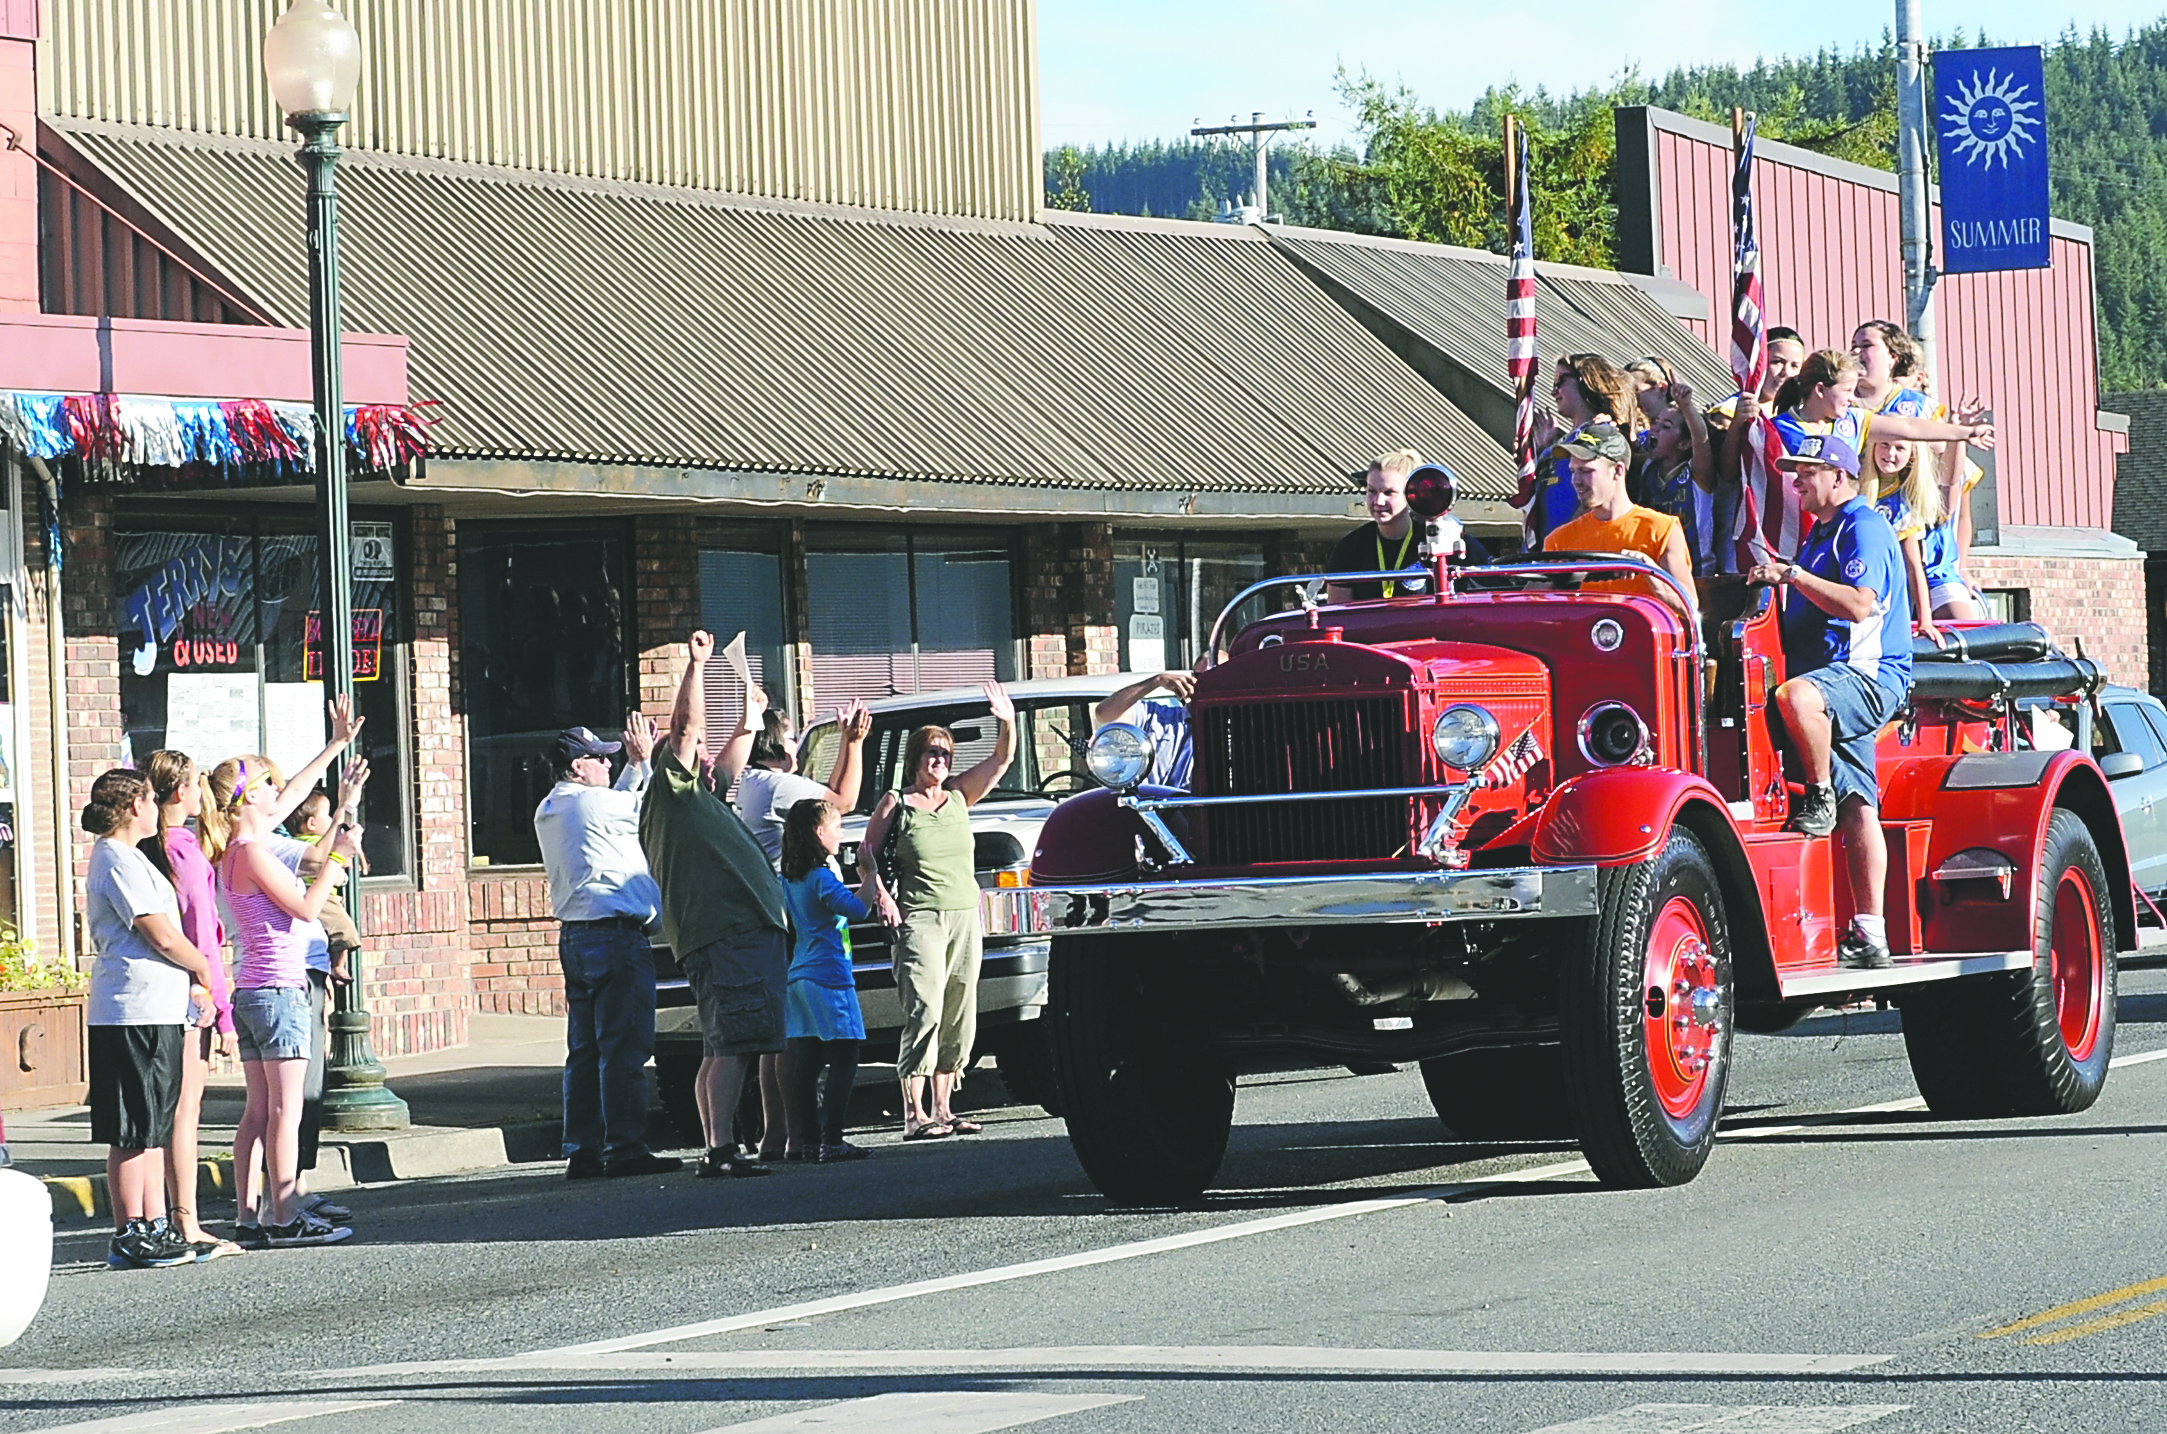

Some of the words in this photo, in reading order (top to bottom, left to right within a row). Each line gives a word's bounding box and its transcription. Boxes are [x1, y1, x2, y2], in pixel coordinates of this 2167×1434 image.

[1950, 217, 2041, 249] SUMMER
[193, 601, 233, 629] NEW
[173, 622, 191, 667] &
[193, 634, 238, 665] USED
[1280, 652, 1329, 671] USA
